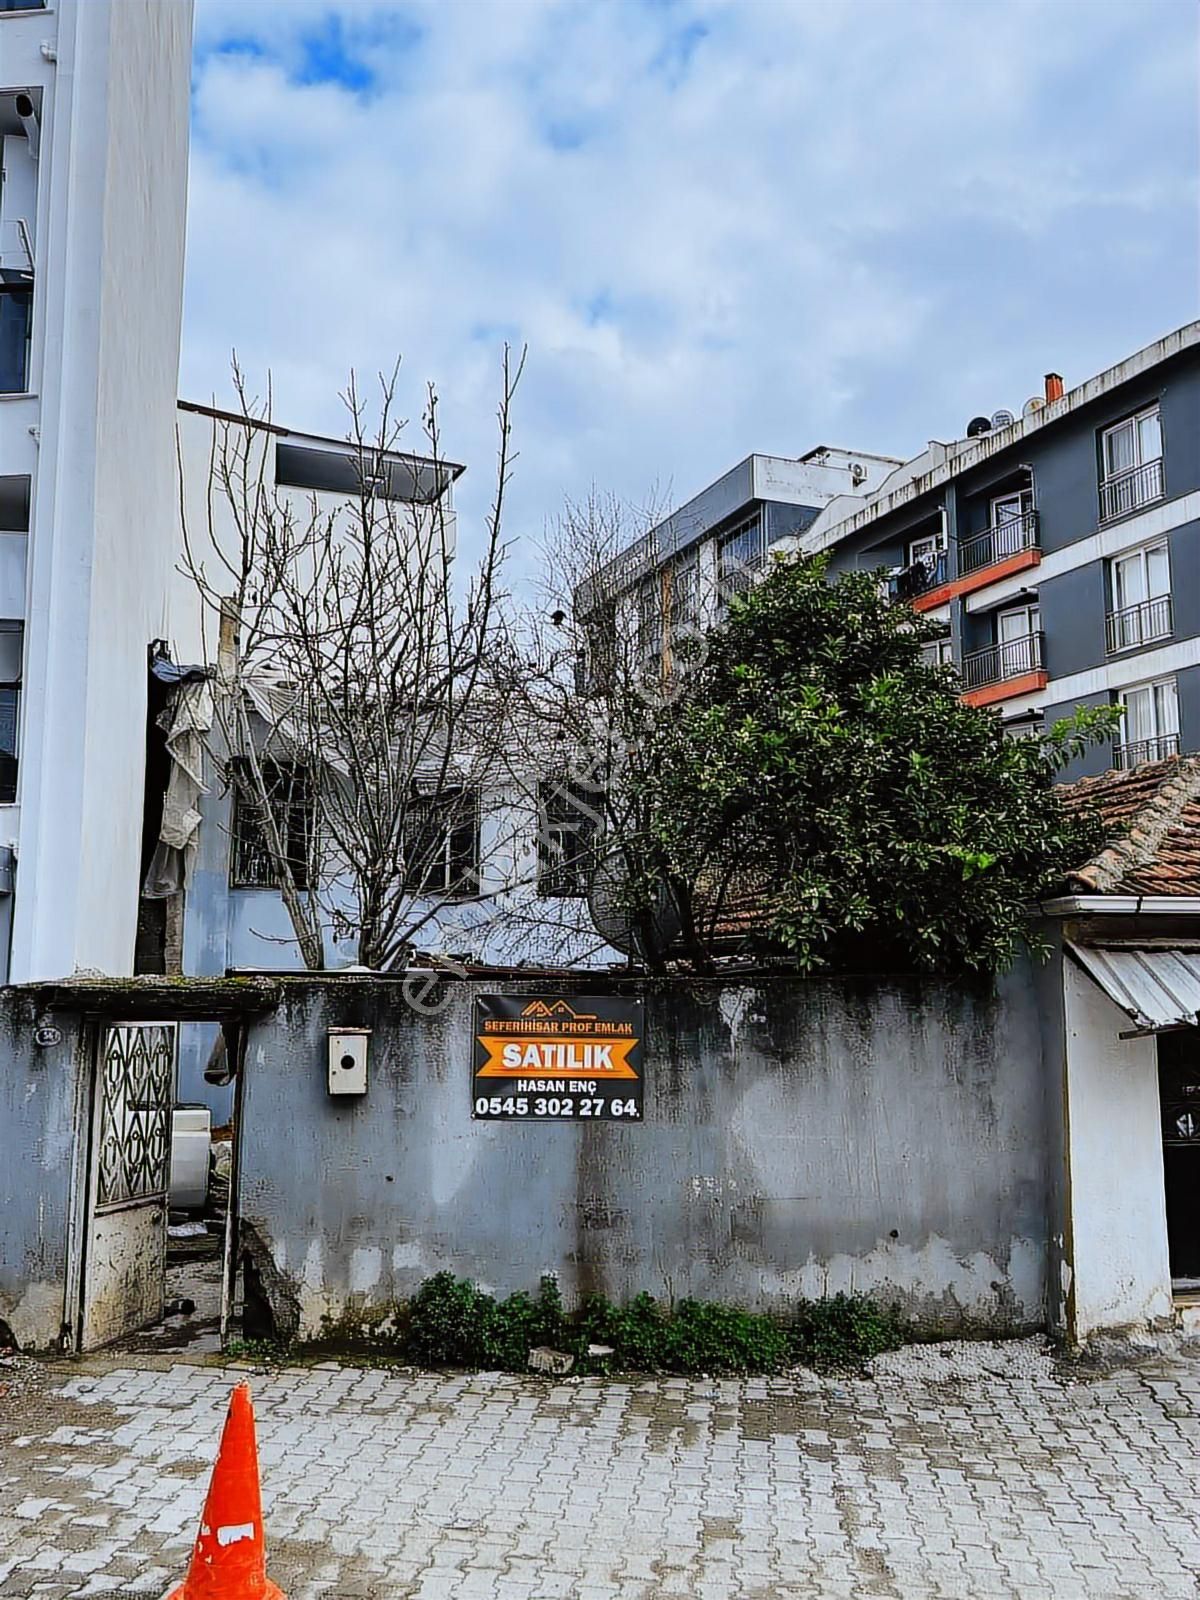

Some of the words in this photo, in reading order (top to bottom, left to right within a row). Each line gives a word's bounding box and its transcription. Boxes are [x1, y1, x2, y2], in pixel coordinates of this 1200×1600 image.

[484, 1019, 559, 1033] SEFERİHİSAR
[562, 1022, 592, 1033] PROF
[595, 1022, 633, 1034] EMLAK
[502, 1043, 614, 1070] SATILIK
[517, 1080, 565, 1092] HASAN
[569, 1080, 597, 1096] ENÇ
[475, 1098, 529, 1115] 0545
[534, 1098, 574, 1116] 302
[579, 1099, 605, 1116] 27
[610, 1099, 637, 1116] 64
